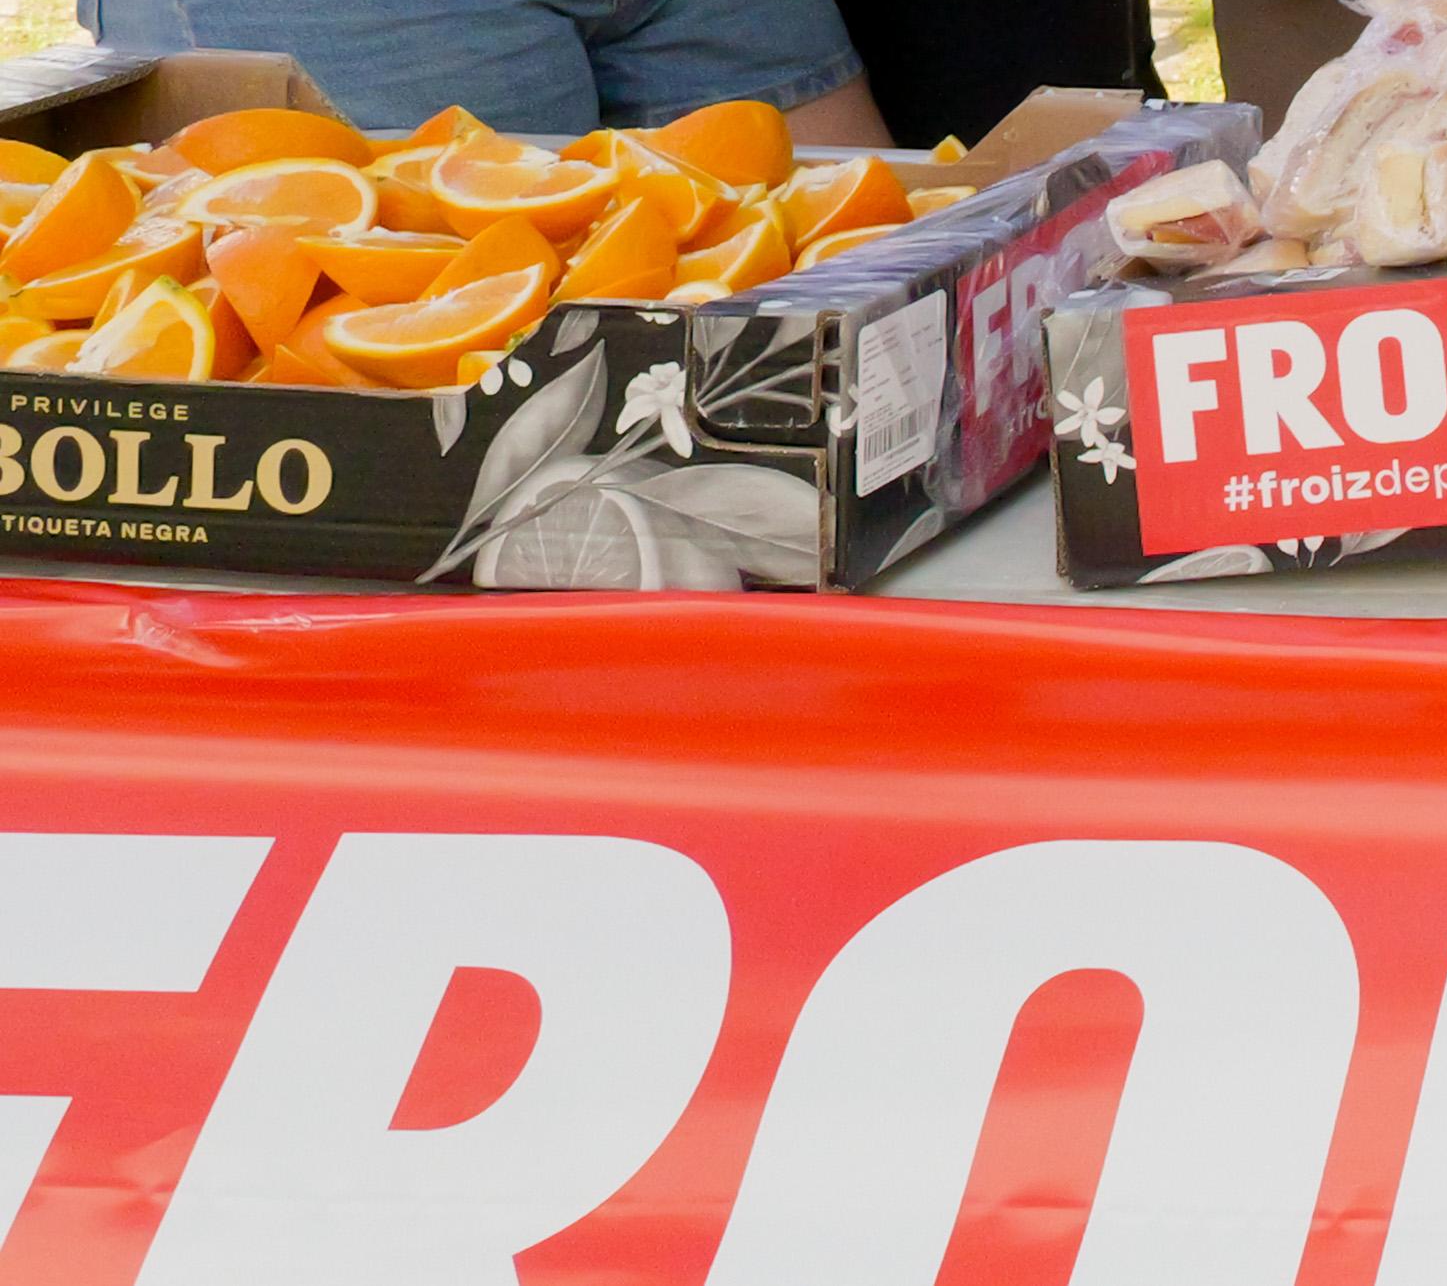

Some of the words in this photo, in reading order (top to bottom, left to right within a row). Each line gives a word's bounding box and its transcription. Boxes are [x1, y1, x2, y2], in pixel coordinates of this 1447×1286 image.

[10, 394, 190, 421] PRIVILEGE
[0, 514, 112, 539] TIQUETA
[121, 522, 210, 544] NEGRA
